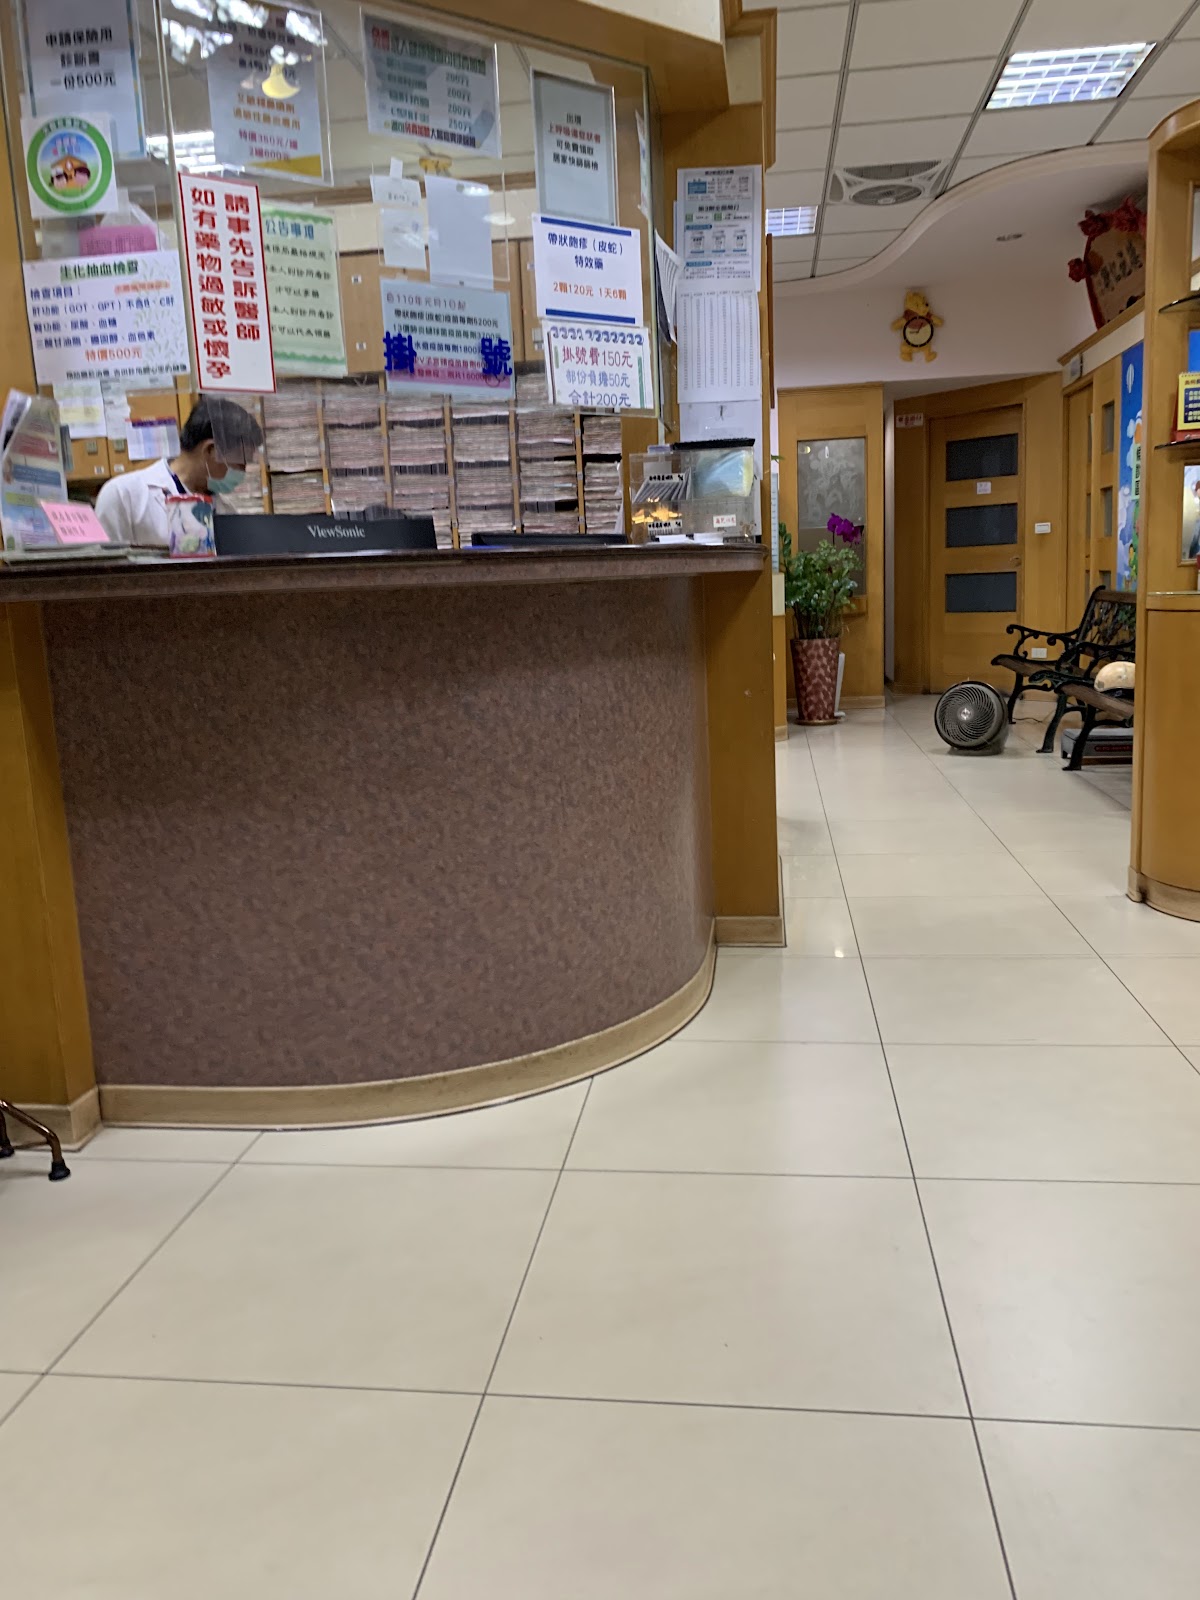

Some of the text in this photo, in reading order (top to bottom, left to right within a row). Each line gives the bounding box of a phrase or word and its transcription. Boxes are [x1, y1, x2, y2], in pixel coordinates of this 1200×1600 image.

[265, 218, 315, 240] 公告事項
[60, 259, 139, 281] 生化抽血檢查
[224, 191, 261, 342] 請事先告訴醫師
[574, 254, 604, 271] 特效藥
[189, 186, 232, 379] 如有藥物過敏或懷孕
[553, 281, 627, 301] 2顆120元 1天6顆
[85, 346, 142, 362] 特價500元
[383, 331, 512, 376] 掛 號
[562, 345, 633, 368] 掛號費150元
[568, 389, 632, 407] 合計200元
[307, 524, 366, 538] ViewSonic
